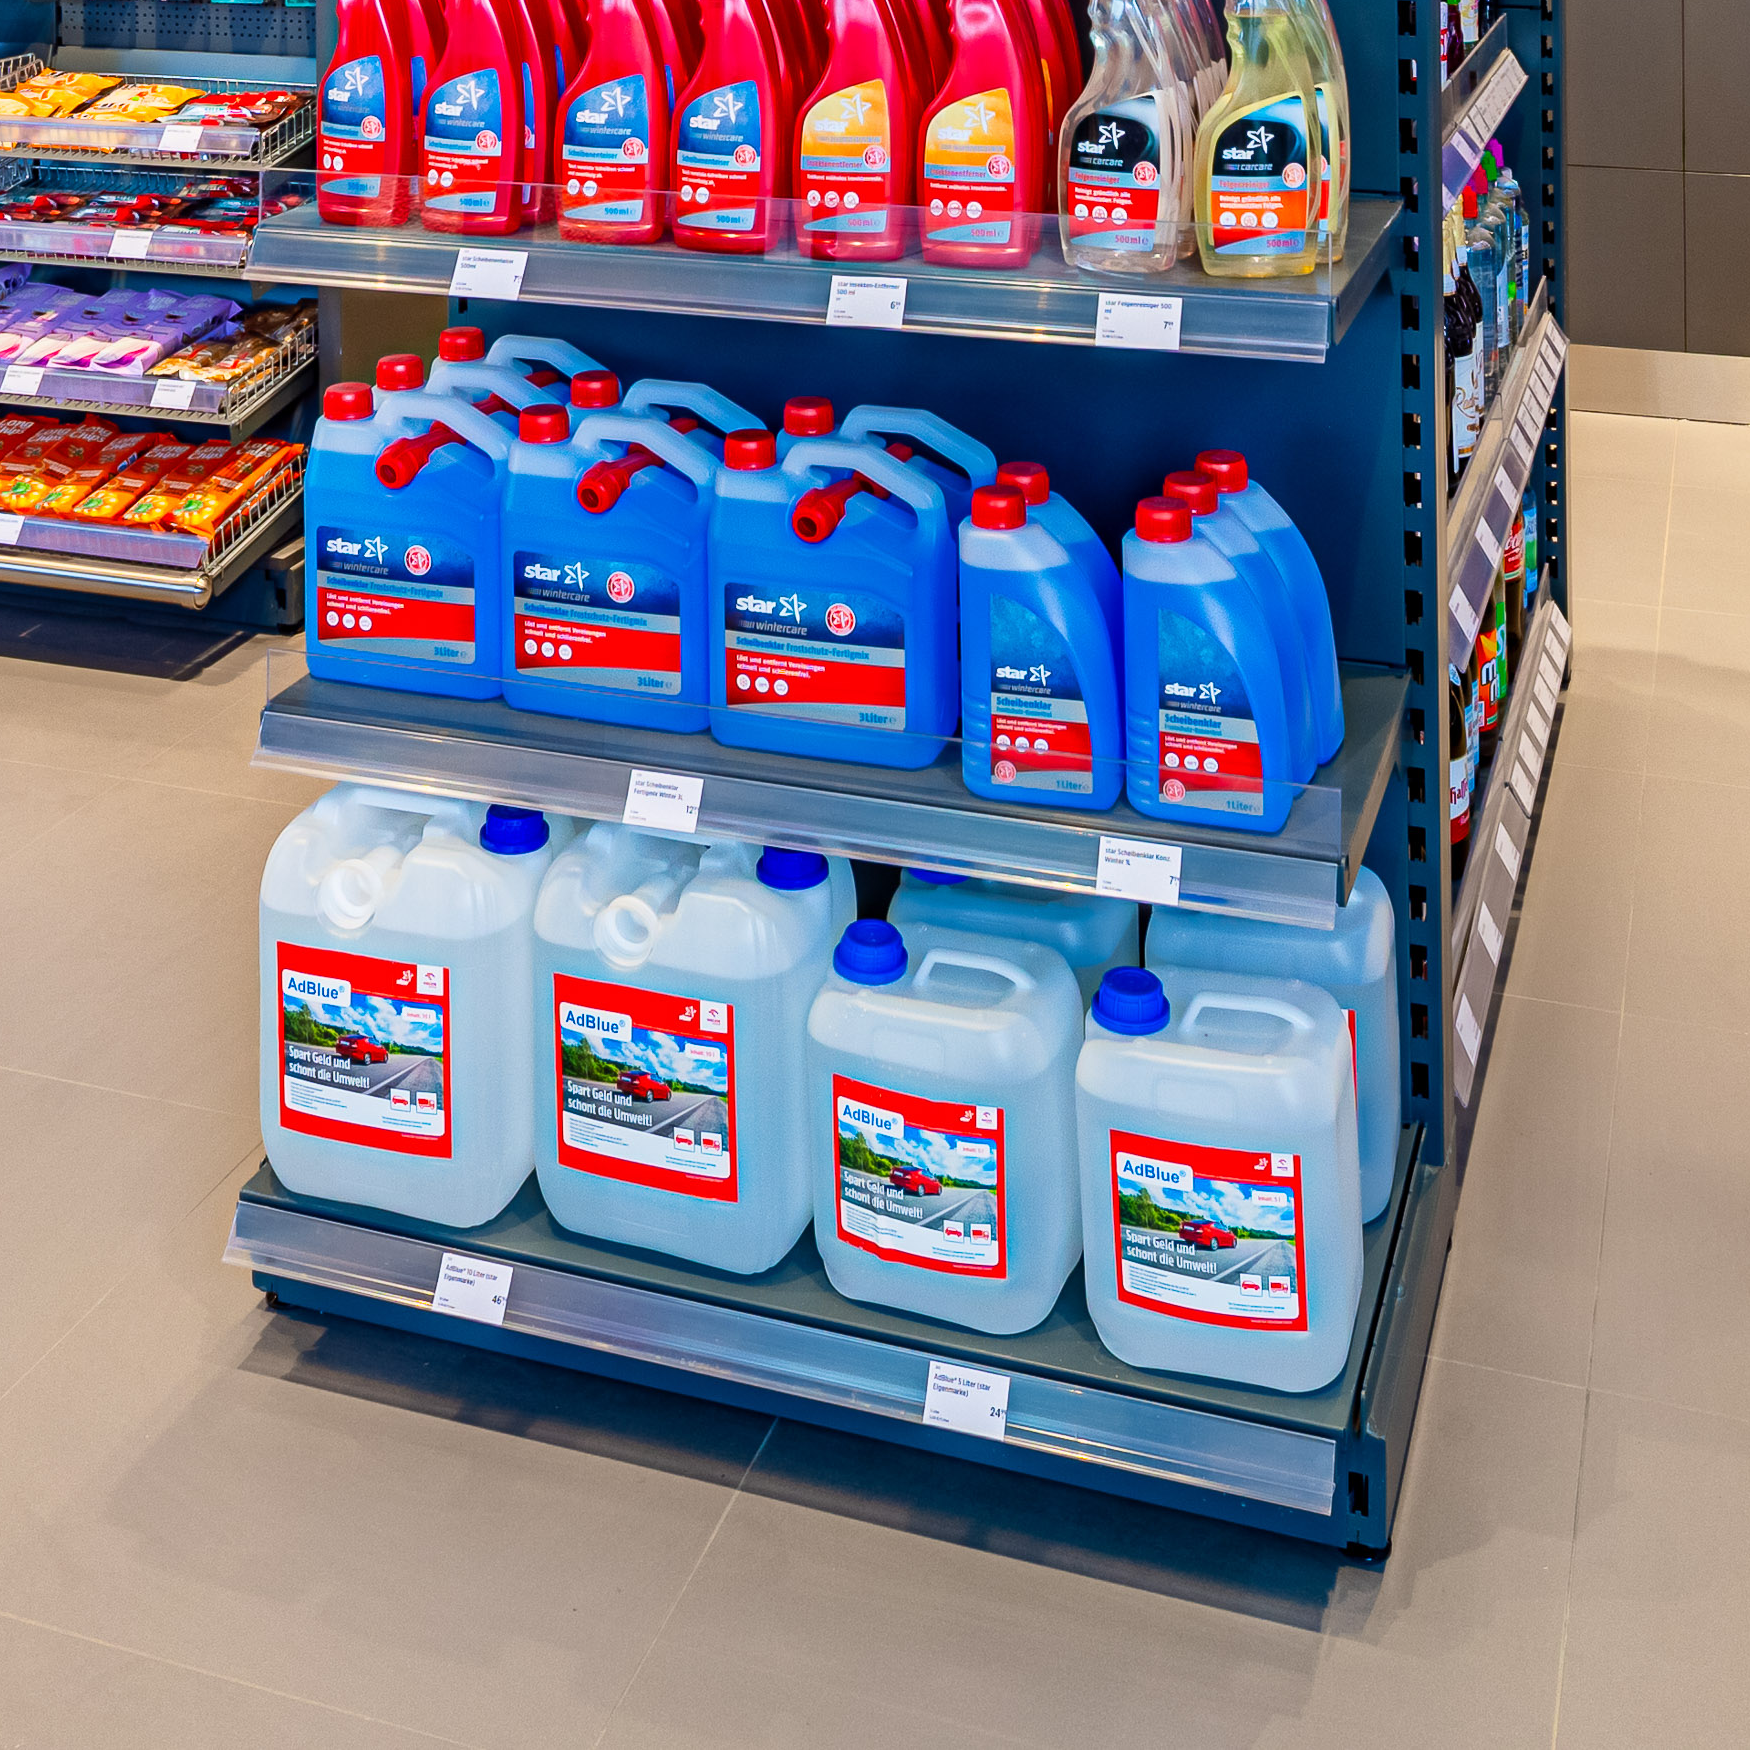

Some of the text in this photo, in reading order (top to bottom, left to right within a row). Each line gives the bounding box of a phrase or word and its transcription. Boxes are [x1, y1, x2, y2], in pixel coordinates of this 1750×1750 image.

[327, 87, 351, 103] star
[434, 100, 464, 117] star
[576, 108, 609, 125] star
[689, 115, 721, 132] star
[814, 116, 848, 135] star
[702, 132, 744, 142] wintercare
[937, 124, 972, 142] star
[1077, 139, 1106, 155] star
[1221, 147, 1255, 160] star
[1091, 156, 1123, 167] carcare
[1239, 160, 1273, 171] carcare
[716, 214, 742, 225] 500ml
[0, 418, 35, 429] Long
[326, 537, 362, 557] star
[343, 561, 389, 575] wintercare
[523, 563, 561, 583] star
[543, 587, 590, 602] wintercare
[735, 594, 775, 614] star
[755, 619, 808, 635] wintercare
[995, 665, 1028, 682] star
[1010, 683, 1052, 695] wintercare
[1165, 682, 1197, 700] star
[996, 697, 1052, 711] Scheibenklar
[1180, 700, 1221, 713] wintercare
[1165, 712, 1222, 730] Scheibenklar
[289, 1046, 351, 1070] Spart Geld und
[289, 1061, 370, 1089] schont die Umwelt!
[567, 1080, 633, 1107] Spart Geld und
[567, 1096, 652, 1127] schont die Umwelt!
[844, 1169, 904, 1199] Spart Geld und
[844, 1185, 923, 1219] schont die Umwelt!
[1125, 1229, 1195, 1256] Spart Geld und
[1126, 1245, 1217, 1275] schont die Umwelt!
